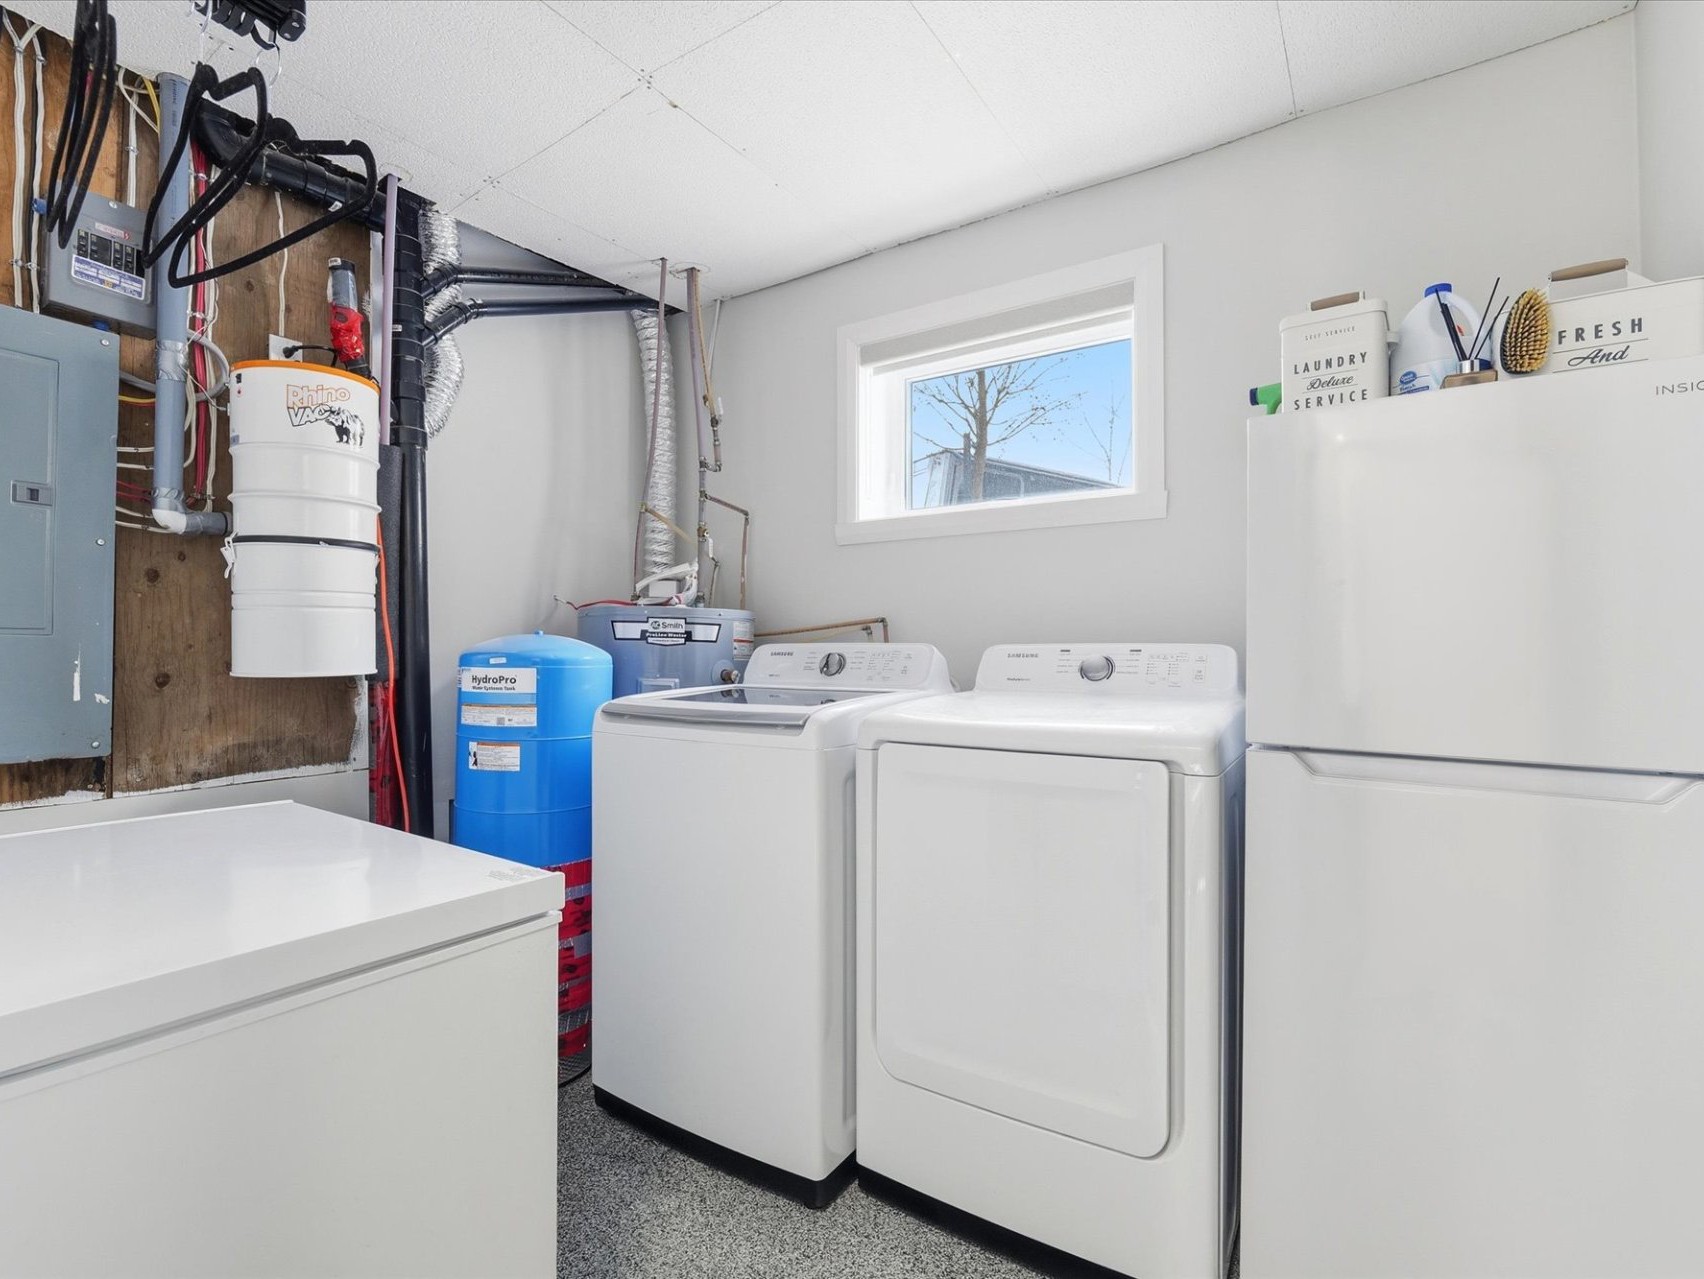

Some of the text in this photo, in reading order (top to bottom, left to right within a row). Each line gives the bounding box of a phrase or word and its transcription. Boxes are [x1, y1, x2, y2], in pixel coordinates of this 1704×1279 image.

[1304, 326, 1356, 341] SELF SERVICE
[1557, 317, 1643, 345] FRESH
[1293, 351, 1368, 375] LAUNDRY
[1567, 345, 1630, 367] And
[1306, 375, 1355, 391] Deluxe
[286, 383, 351, 408] Rhino
[1293, 389, 1369, 410] SERVICE
[287, 403, 332, 427] VAC
[661, 621, 684, 630] Smith
[471, 674, 517, 686] HydroPro
